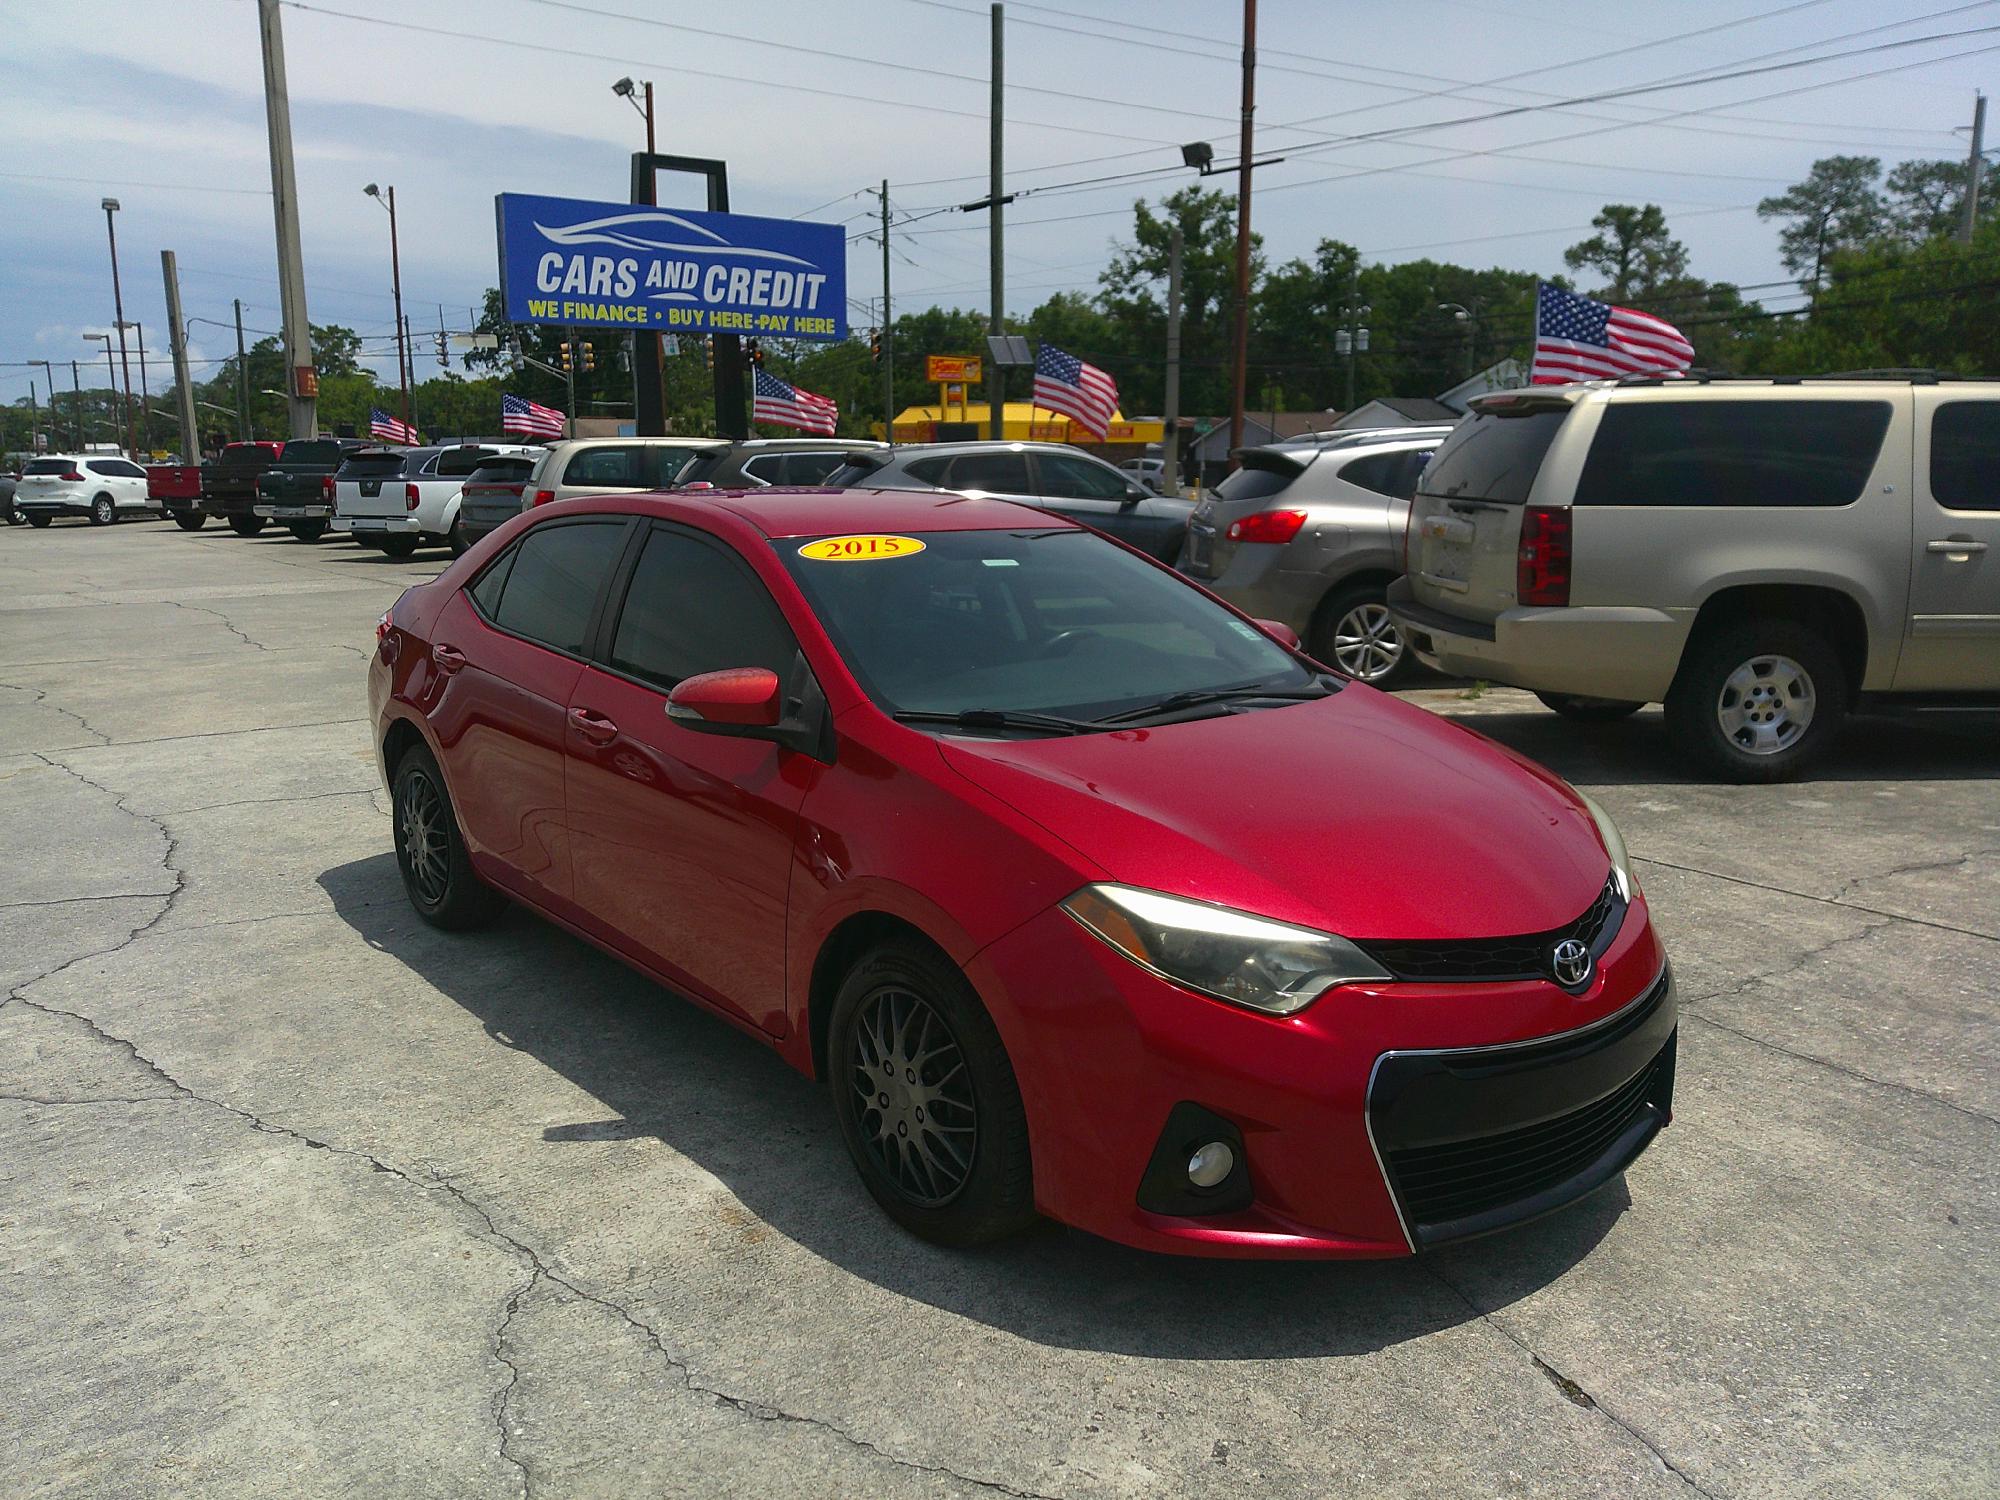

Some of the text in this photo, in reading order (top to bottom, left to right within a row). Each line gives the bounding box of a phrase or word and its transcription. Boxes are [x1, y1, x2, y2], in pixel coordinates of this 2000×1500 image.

[536, 252, 827, 309] CARS AND CREDIT
[528, 300, 559, 318] WE
[564, 302, 648, 323] FINANCE
[669, 308, 704, 325] BUY
[794, 317, 835, 334] HERE
[826, 538, 900, 557] 2015
